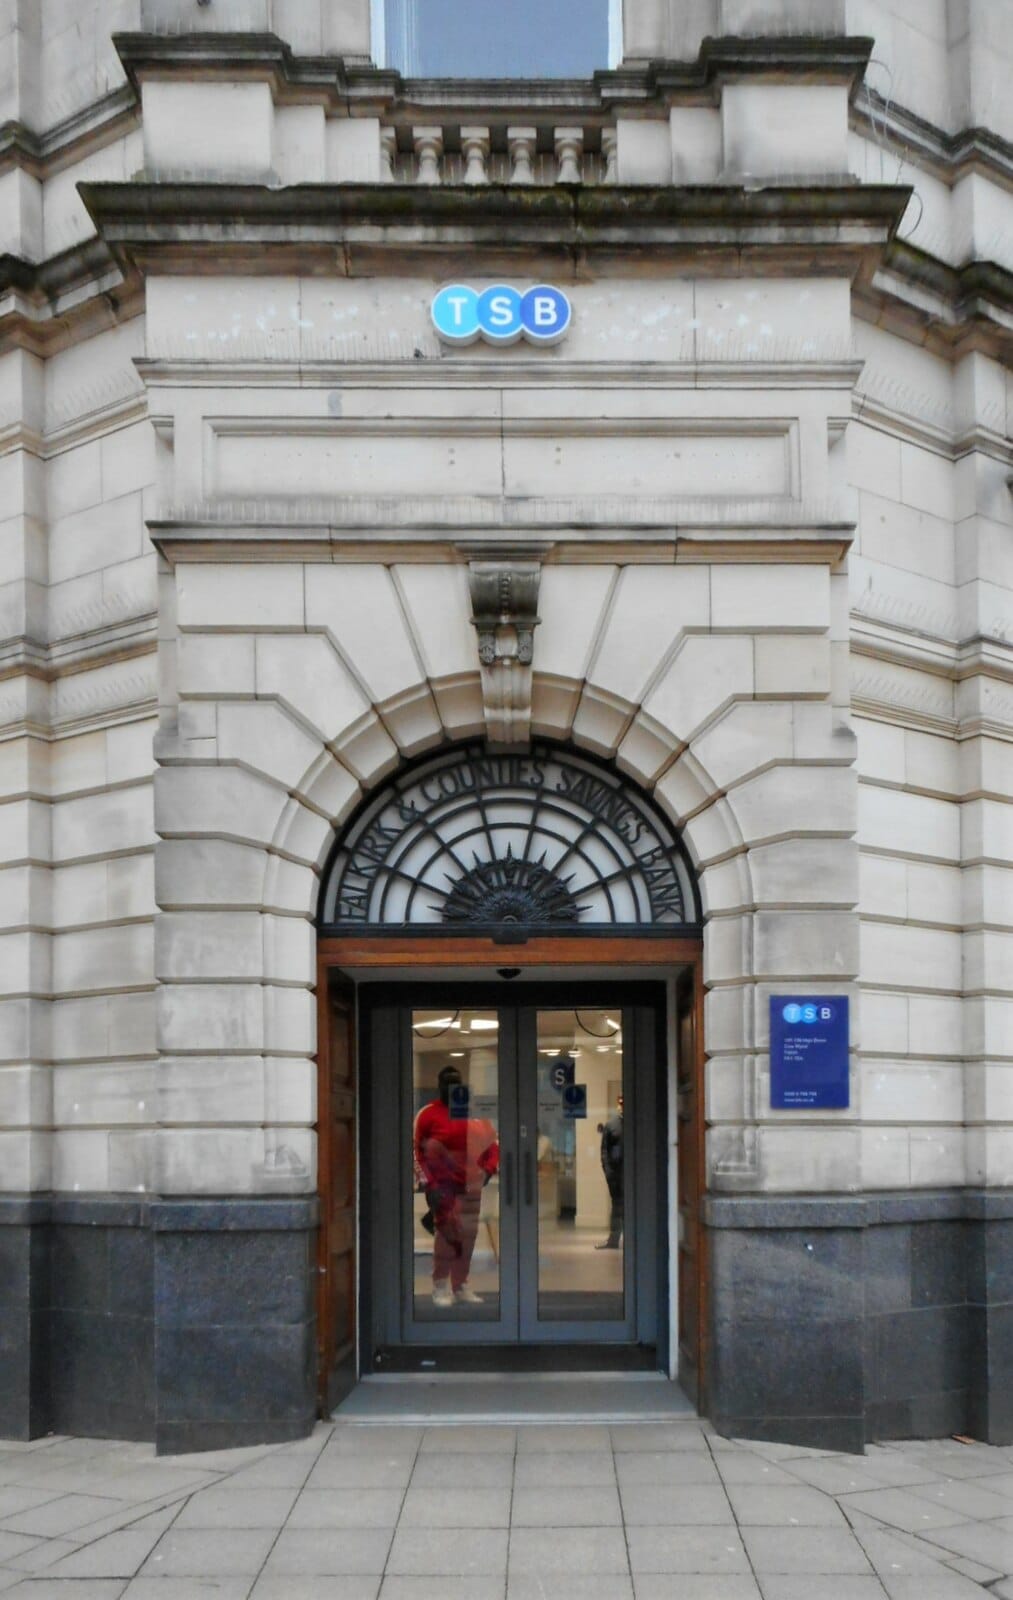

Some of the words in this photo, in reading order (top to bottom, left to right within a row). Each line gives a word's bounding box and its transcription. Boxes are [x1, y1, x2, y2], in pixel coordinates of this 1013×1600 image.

[447, 297, 558, 326] TSB
[338, 818, 403, 921] FALKIRK
[399, 800, 423, 824] &
[420, 760, 547, 803] COUNTIES
[556, 768, 650, 845] SAVINGS
[639, 846, 684, 921] BANK
[787, 1007, 832, 1020] TSB
